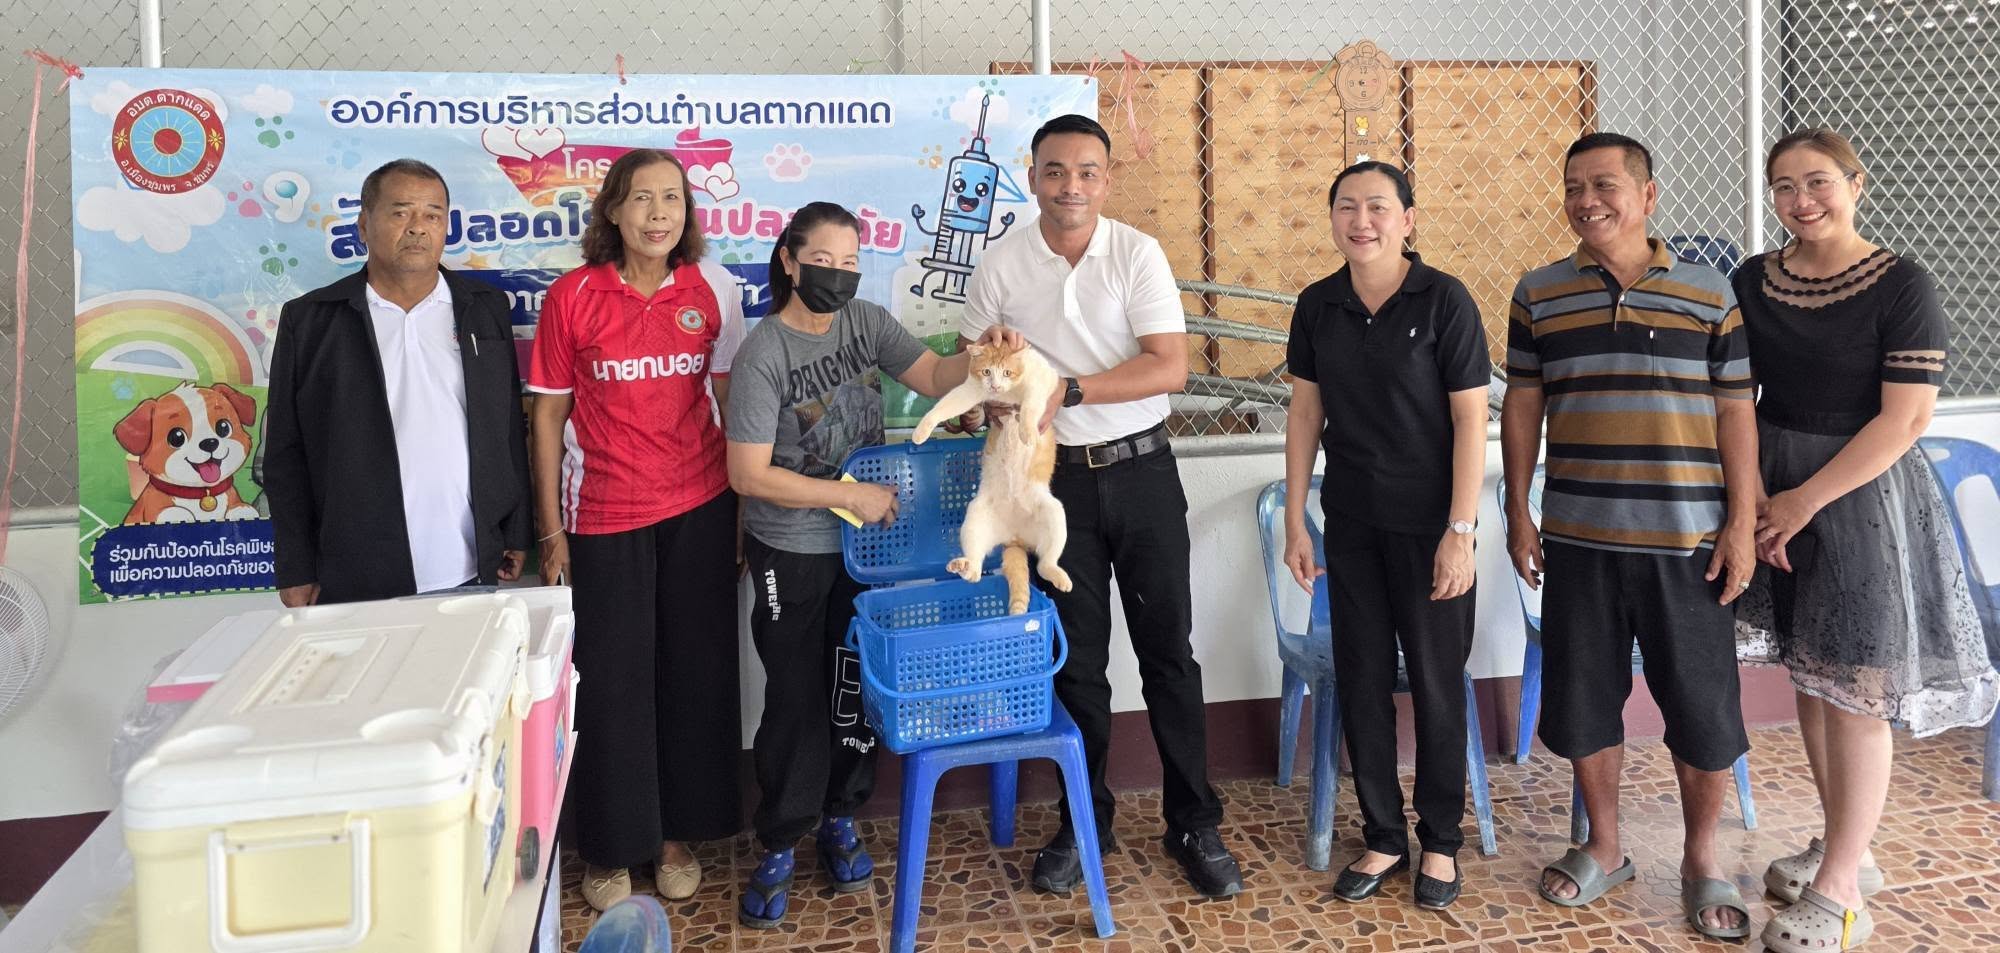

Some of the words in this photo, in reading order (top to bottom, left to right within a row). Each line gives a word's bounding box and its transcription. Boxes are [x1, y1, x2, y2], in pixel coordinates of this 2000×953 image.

[331, 91, 892, 125] องค์การบริหารส่วนตำบลตากแดด
[562, 147, 613, 179] โคร
[593, 352, 705, 382] นายกบอย
